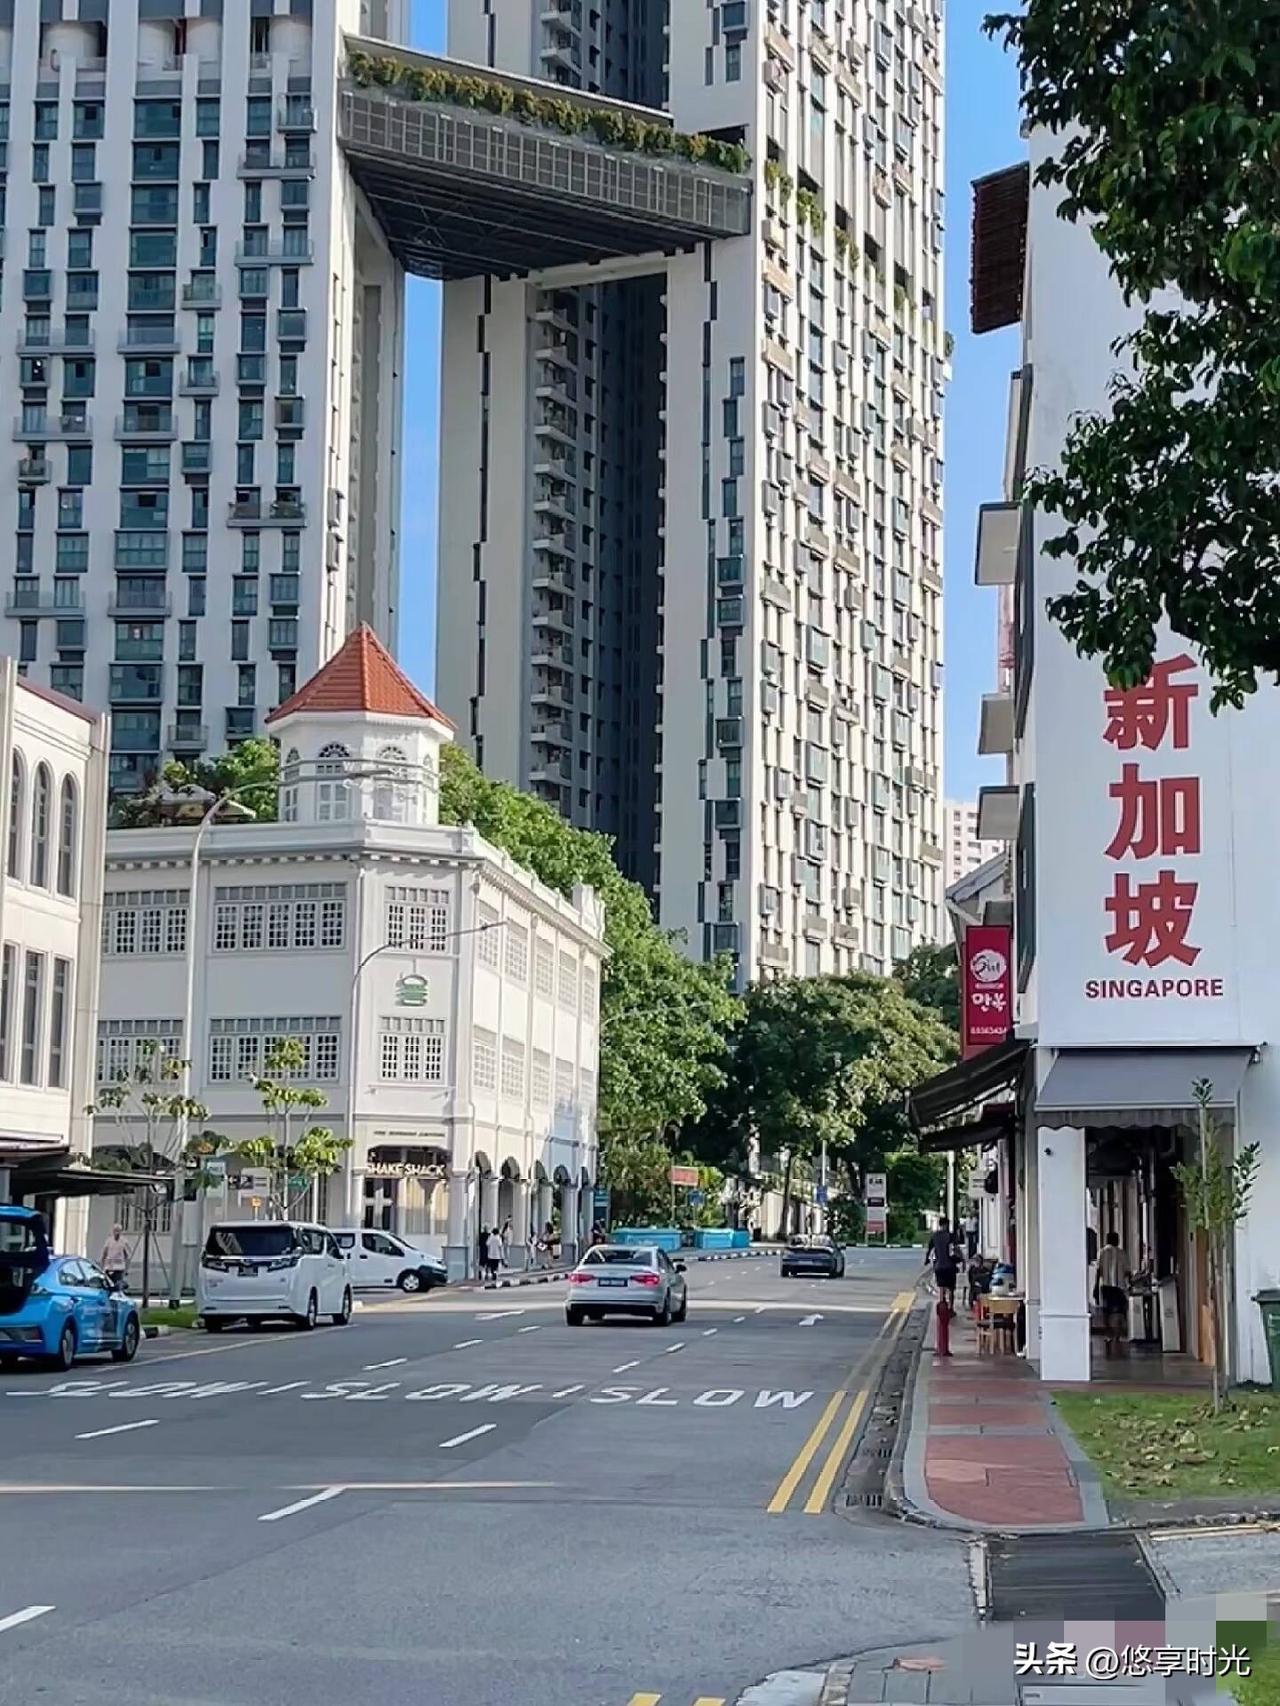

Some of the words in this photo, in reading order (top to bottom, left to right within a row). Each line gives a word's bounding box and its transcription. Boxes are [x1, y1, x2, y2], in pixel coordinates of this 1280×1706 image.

[1103, 656, 1199, 966] 新加坡
[1085, 979, 1224, 999] SINGAPORE
[366, 1161, 404, 1175] SHAKE
[404, 1162, 446, 1177] SHACK
[301, 1382, 544, 1402] SLOW
[590, 1386, 815, 1409] SLOW
